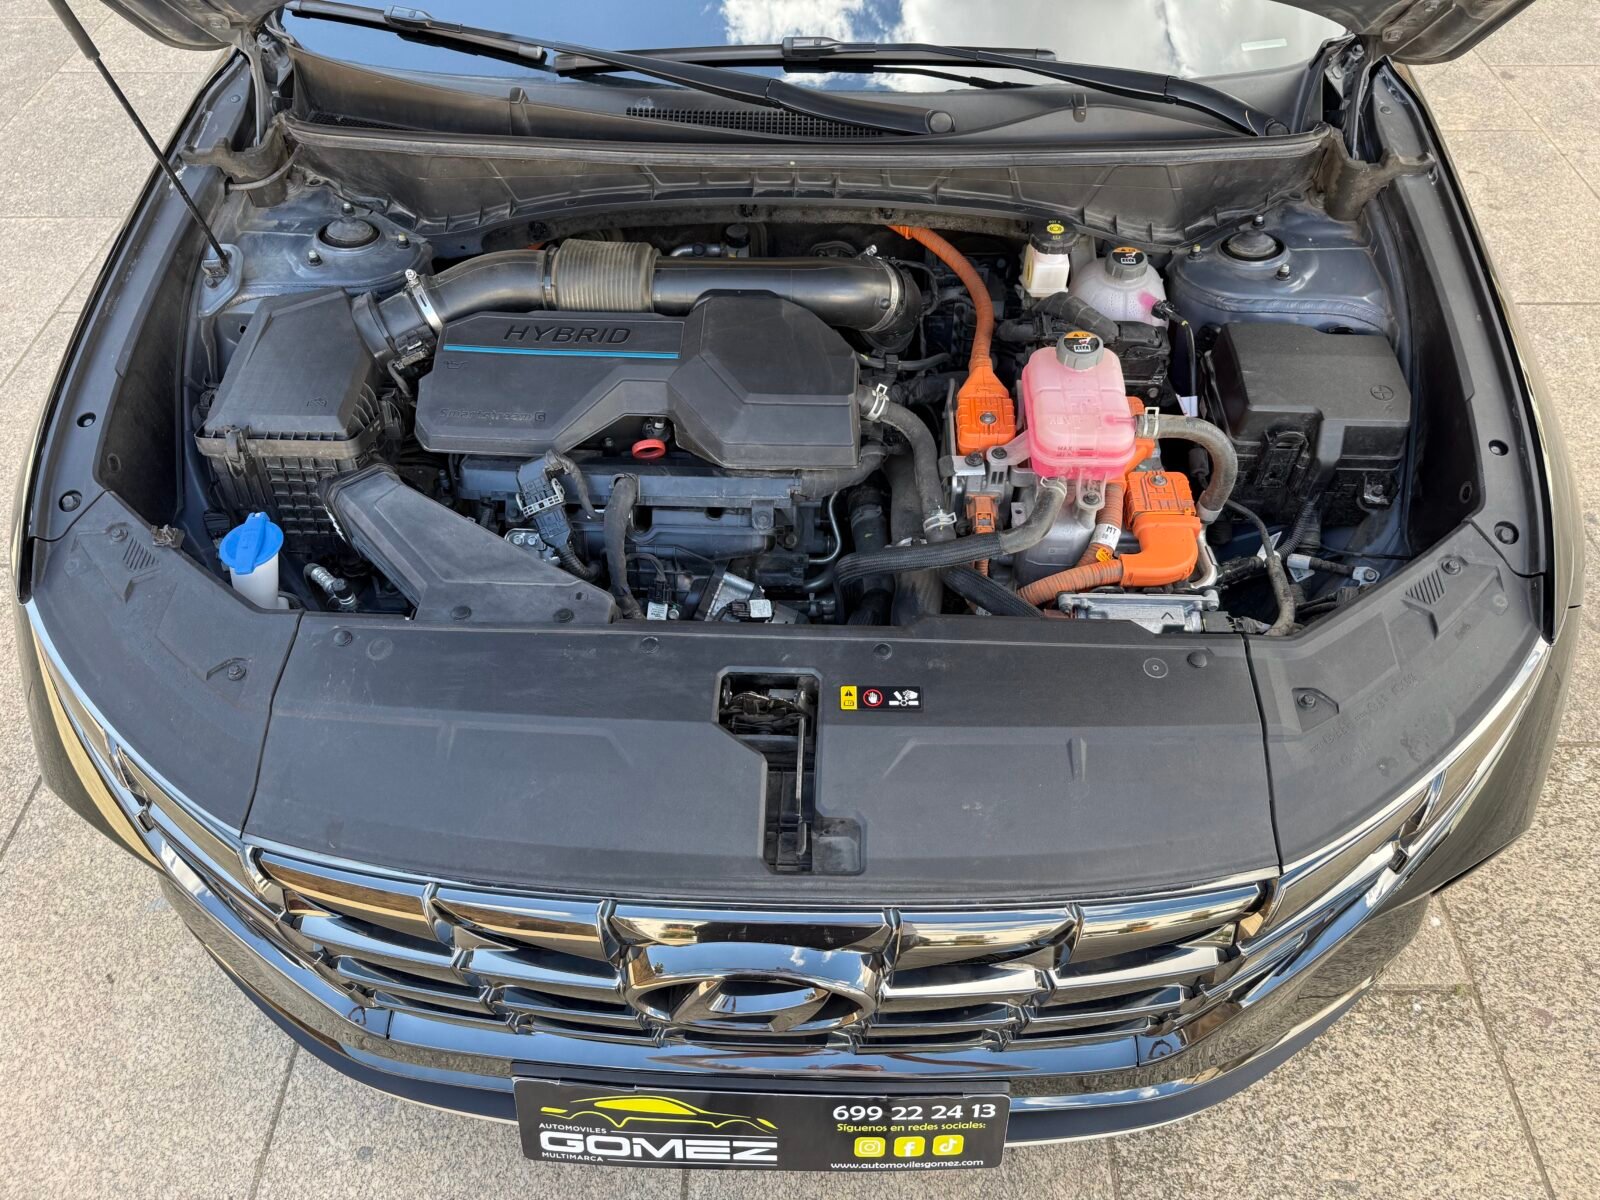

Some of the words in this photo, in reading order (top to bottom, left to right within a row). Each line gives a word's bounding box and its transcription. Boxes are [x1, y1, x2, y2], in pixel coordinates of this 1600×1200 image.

[503, 324, 631, 344] HYBRID
[439, 408, 532, 421] Smartstream
[832, 1105, 883, 1121] 699
[891, 1106, 923, 1121] 22
[931, 1105, 963, 1119] 24
[971, 1103, 996, 1118] 13
[538, 1122, 607, 1134] AUTOMOVILES
[836, 1122, 887, 1132] Síguenos
[908, 1122, 938, 1131] redes
[941, 1121, 986, 1130] sociales:
[539, 1131, 778, 1161] GOMEZ
[541, 1151, 604, 1162] MULTIMARCA
[830, 1159, 984, 1170] www.automovilesgomez.com
